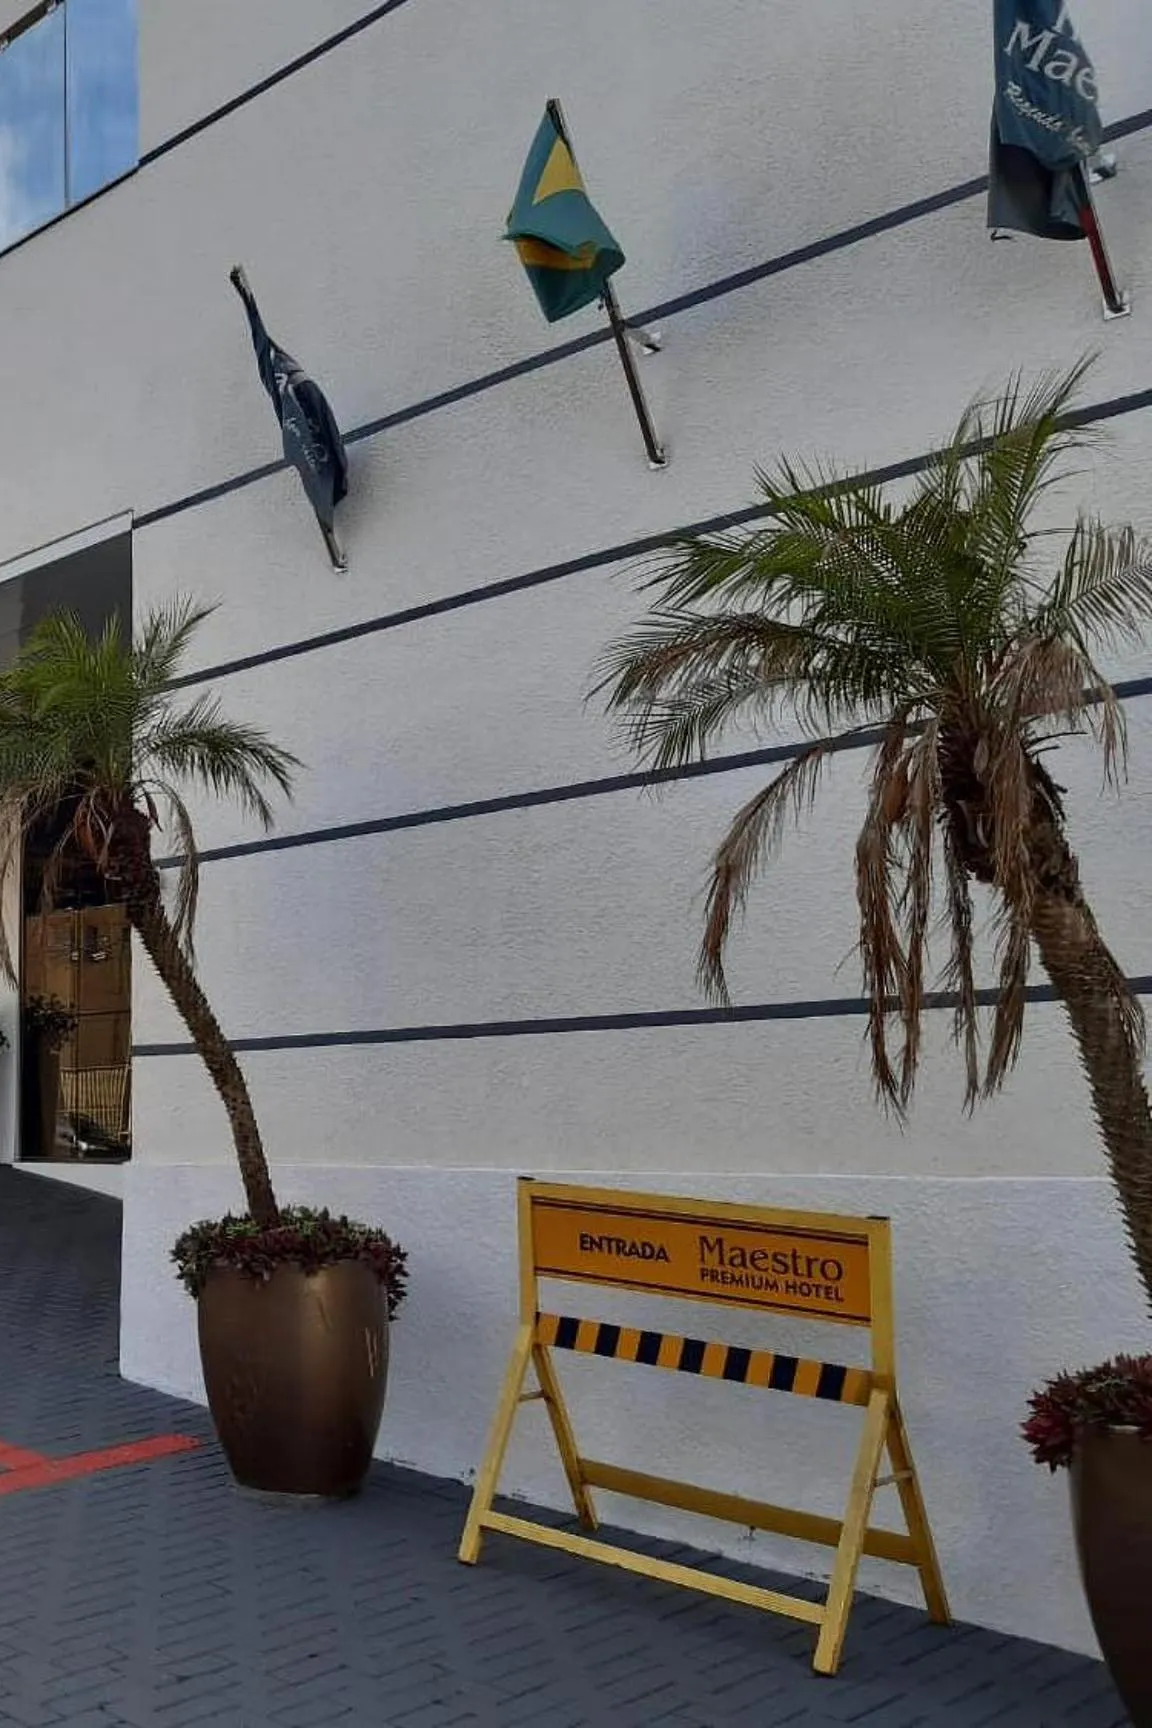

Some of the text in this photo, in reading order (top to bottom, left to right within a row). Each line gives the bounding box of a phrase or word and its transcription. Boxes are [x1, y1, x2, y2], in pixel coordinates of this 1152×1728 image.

[579, 1232, 671, 1264] ENTRADA
[698, 1235, 844, 1282] Maestro
[700, 1267, 845, 1302] PREMIUM HOTEL
